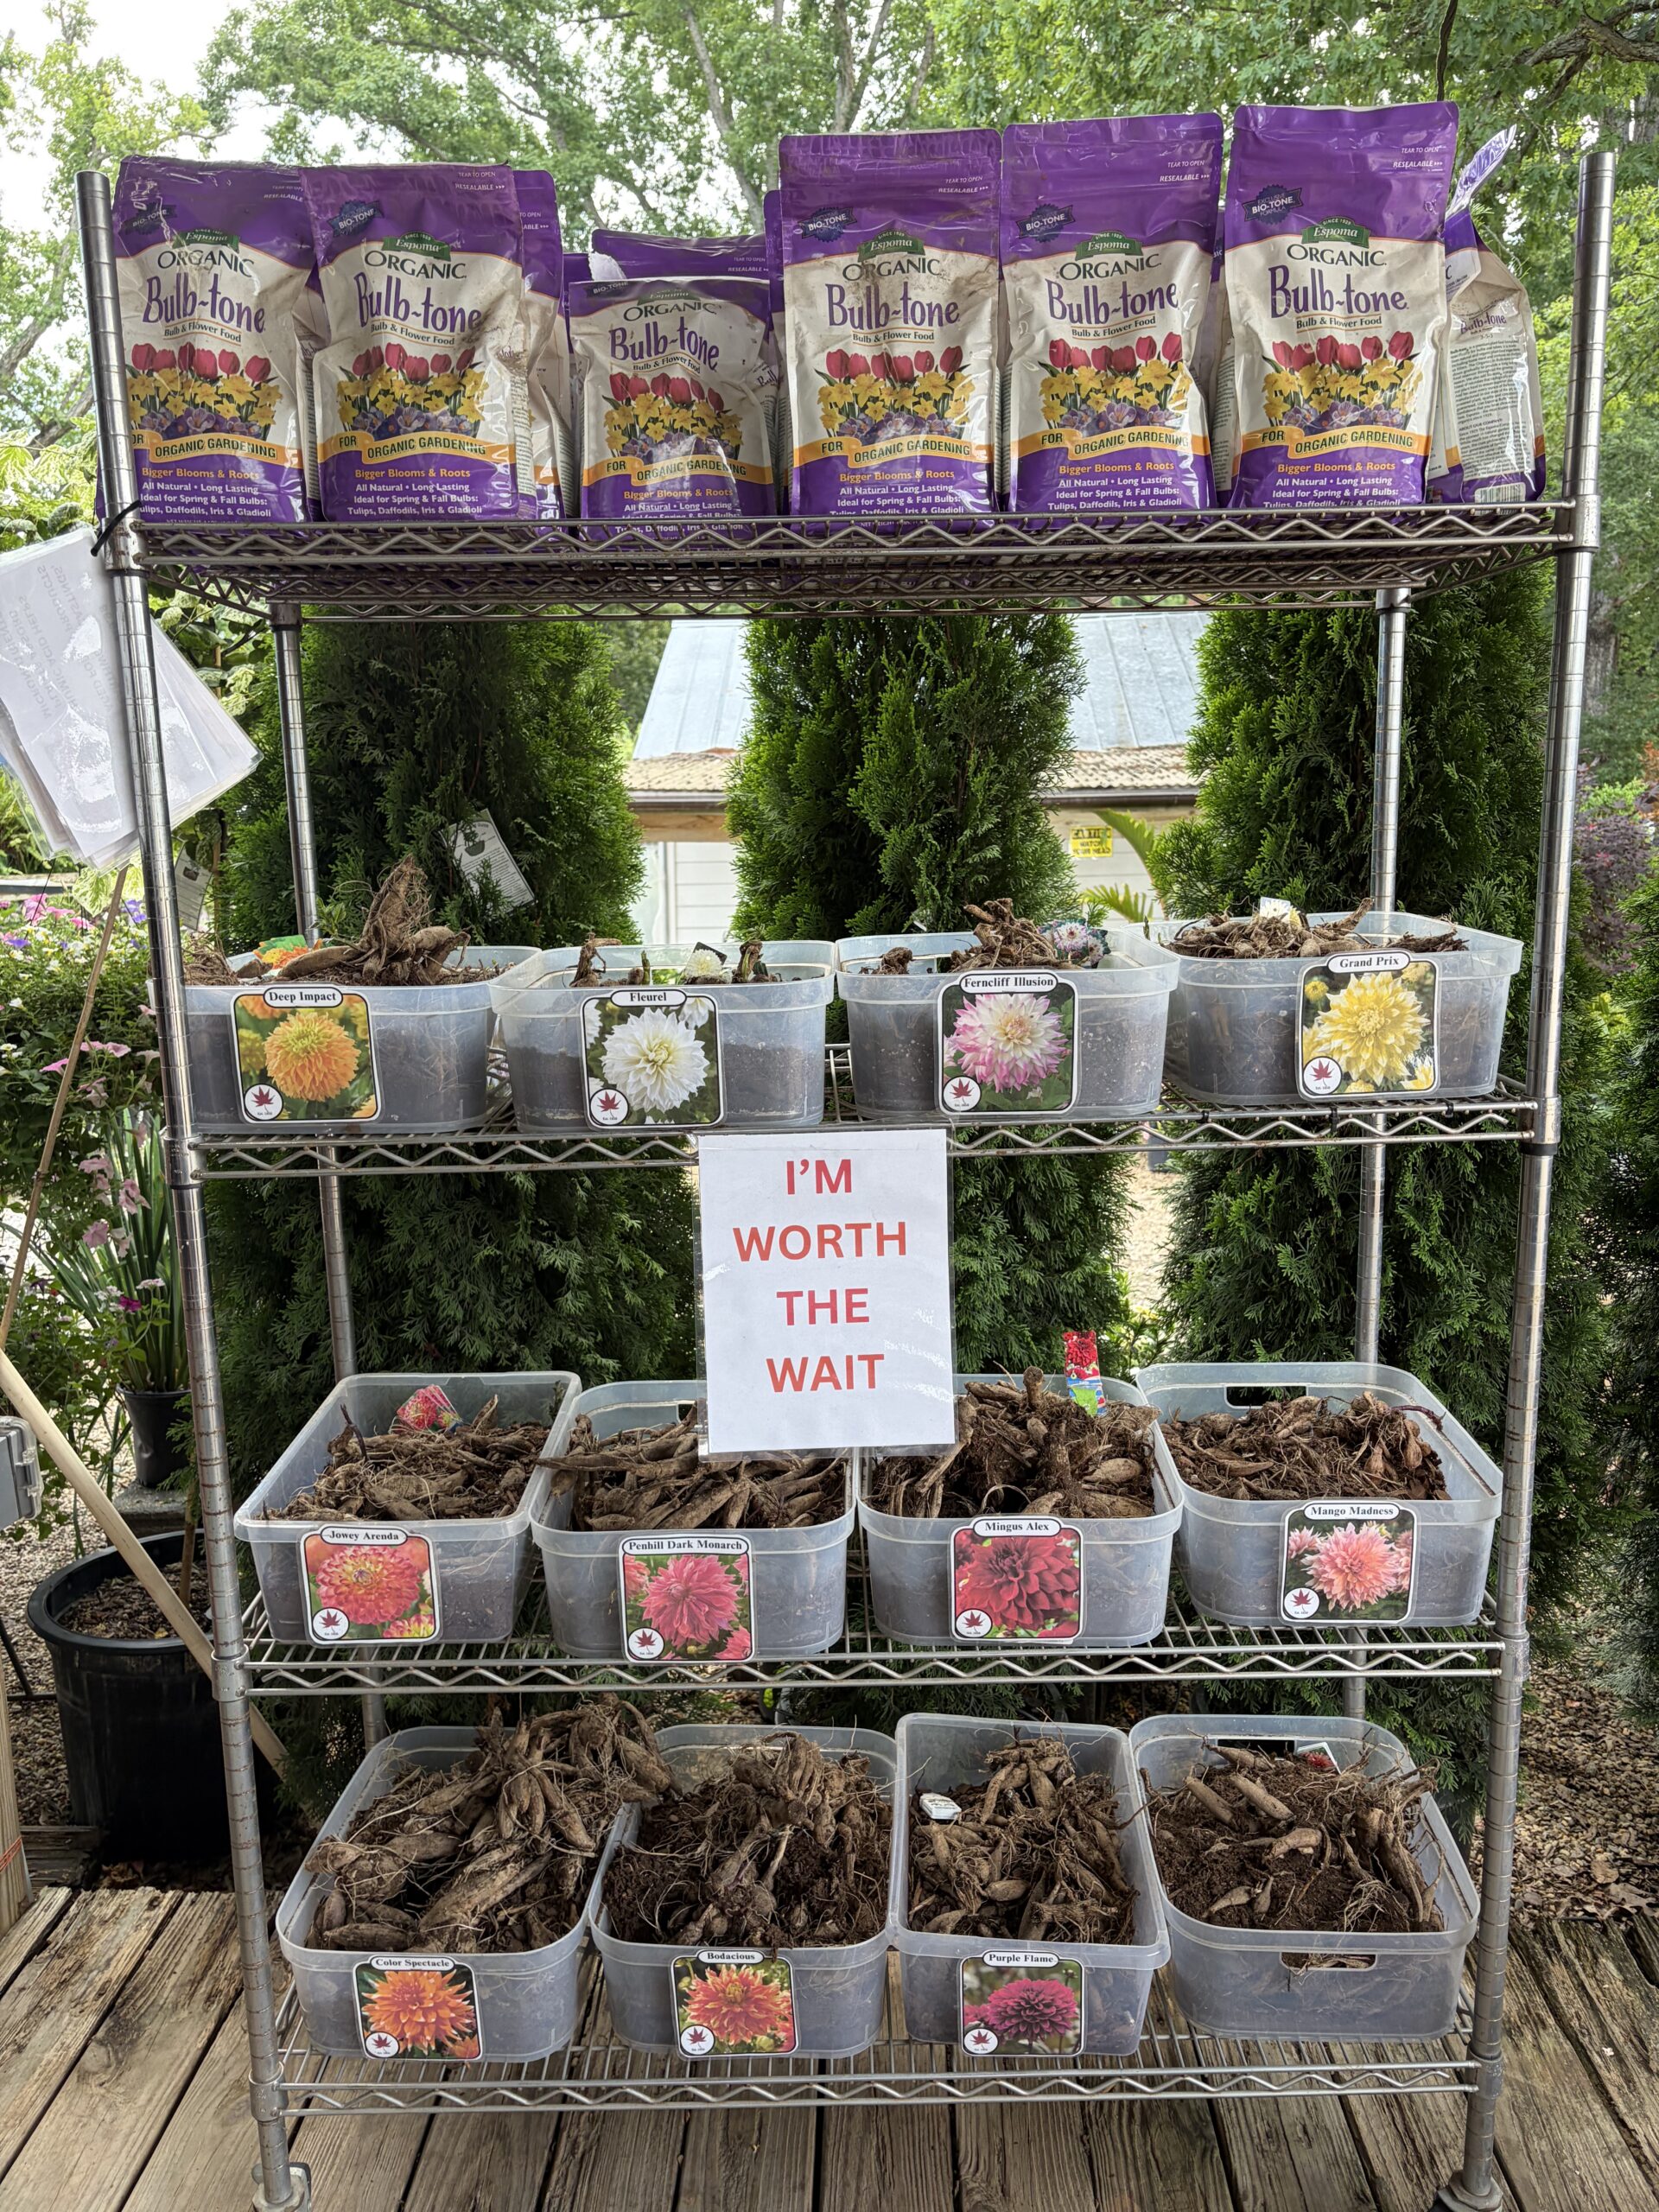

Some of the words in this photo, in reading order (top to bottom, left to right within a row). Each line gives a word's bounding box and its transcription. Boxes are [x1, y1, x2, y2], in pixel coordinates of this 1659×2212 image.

[1393, 160, 1433, 168] RESEALABLE
[1160, 173, 1199, 182] RESEALABLE
[1252, 196, 1294, 213] BIO-TONE
[1257, 193, 1285, 204] EXCLUSIVE
[1260, 206, 1286, 217] FORMULA
[339, 209, 374, 229] BIO-TONE
[809, 213, 847, 231] BIO-TONE
[1026, 213, 1065, 232] BIO-TONE
[186, 232, 228, 241] Espoma
[1313, 227, 1358, 238] Espoma
[396, 238, 441, 252] Espoma
[870, 238, 912, 251] Espoma
[1087, 240, 1130, 251] Espoma
[1287, 244, 1387, 266] ORGANIC
[158, 250, 255, 277] ORGANIC
[364, 251, 467, 279] ORGANIC
[842, 257, 940, 281] ORGANIC
[1059, 254, 1161, 280] ORGANIC
[594, 282, 628, 294] BIO-TONE
[1268, 264, 1409, 319] Bulb-tone
[143, 272, 265, 334] Bulb-tone
[353, 271, 481, 333] Bulb-tone
[825, 282, 960, 330] Bulb-tone
[1045, 278, 1180, 325] Bulb-tone
[624, 302, 717, 321] ORGANIC
[1072, 328, 1090, 337] Bulb
[1103, 324, 1131, 336] Flower
[1135, 316, 1156, 327] Food
[1297, 318, 1317, 328] Bulb
[1329, 317, 1357, 327] Flower
[1359, 316, 1382, 326] Food
[164, 326, 180, 337] Bulb
[188, 321, 218, 334] Flower
[220, 329, 241, 343] Food
[372, 321, 388, 333] Bulb
[400, 327, 430, 341] Flower
[433, 335, 454, 346] Food
[853, 333, 872, 343] Bulb
[883, 331, 912, 340] Flower
[914, 331, 934, 340] Food
[609, 317, 719, 372] Bulb-tone
[633, 362, 652, 372] Bulb
[661, 356, 687, 365] Flower
[688, 360, 701, 374] Food
[155, 439, 205, 457] ORGANIC
[207, 438, 276, 458] GARDENING
[339, 435, 357, 448] FOR
[367, 438, 415, 459] ORGANIC
[419, 436, 486, 454] GARDENING
[1041, 432, 1063, 445] FOR
[1074, 434, 1124, 454] ORGANIC
[1128, 432, 1189, 448] GARDENING
[1262, 430, 1284, 442] FOR
[1295, 433, 1348, 454] ORGANIC
[1351, 431, 1413, 447] GARDENING
[822, 441, 843, 453] FOR
[854, 443, 904, 463] ORGANIC
[907, 440, 970, 456] GARDENING
[143, 468, 173, 478] Bigger
[176, 468, 214, 478] Blooms
[218, 469, 225, 478] &
[229, 469, 259, 480] Roots
[355, 469, 385, 480] Bigger
[388, 469, 425, 478] Blooms
[440, 469, 471, 478] Roots
[607, 461, 626, 472] FOR
[637, 462, 683, 481] ORGANIC
[687, 460, 747, 475] GARDENING
[1058, 465, 1092, 475] Bigger
[1095, 463, 1132, 472] Blooms
[1135, 462, 1142, 471] &
[1146, 462, 1174, 471] Roots
[1278, 464, 1312, 475] Bigger
[1314, 462, 1352, 472] Blooms
[1355, 462, 1363, 471] &
[1366, 461, 1395, 470] Roots
[840, 474, 871, 484] Bigger
[874, 472, 912, 480] Blooms
[1058, 479, 1071, 487] All
[1073, 478, 1109, 486] Natural
[1117, 477, 1139, 486] Long
[1141, 476, 1173, 486] Lasting
[1276, 477, 1289, 486] All
[1292, 477, 1327, 486] Natural
[1337, 476, 1358, 486] Long
[1361, 476, 1393, 486] Lasting
[624, 491, 654, 501] Bigger
[1095, 490, 1123, 500] Spring
[1273, 489, 1294, 498] Ideal
[1297, 489, 1311, 498] for
[1313, 489, 1342, 499] Spring
[1344, 488, 1351, 497] &
[1372, 487, 1399, 496] Bulbs:
[1339, 958, 1372, 968] Grand
[1376, 957, 1399, 966] Prix
[964, 977, 1011, 988] Ferncliff
[1014, 976, 1054, 987] Illusion
[270, 992, 296, 1003] Deep
[300, 992, 336, 1002] Impact
[630, 992, 667, 1001] Fleurel
[785, 1159, 852, 1195] I'M
[733, 1221, 906, 1262] WORTH
[776, 1288, 870, 1326] THE
[766, 1353, 885, 1393] WAIT
[1311, 1507, 1345, 1516] Mango
[1349, 1506, 1394, 1516] Madness
[985, 1522, 1023, 1532] Mingus
[330, 1531, 359, 1541] Jowey
[629, 1541, 664, 1550] Penhill
[697, 1540, 742, 1550] Monarch
[989, 1955, 1020, 1963] Purple
